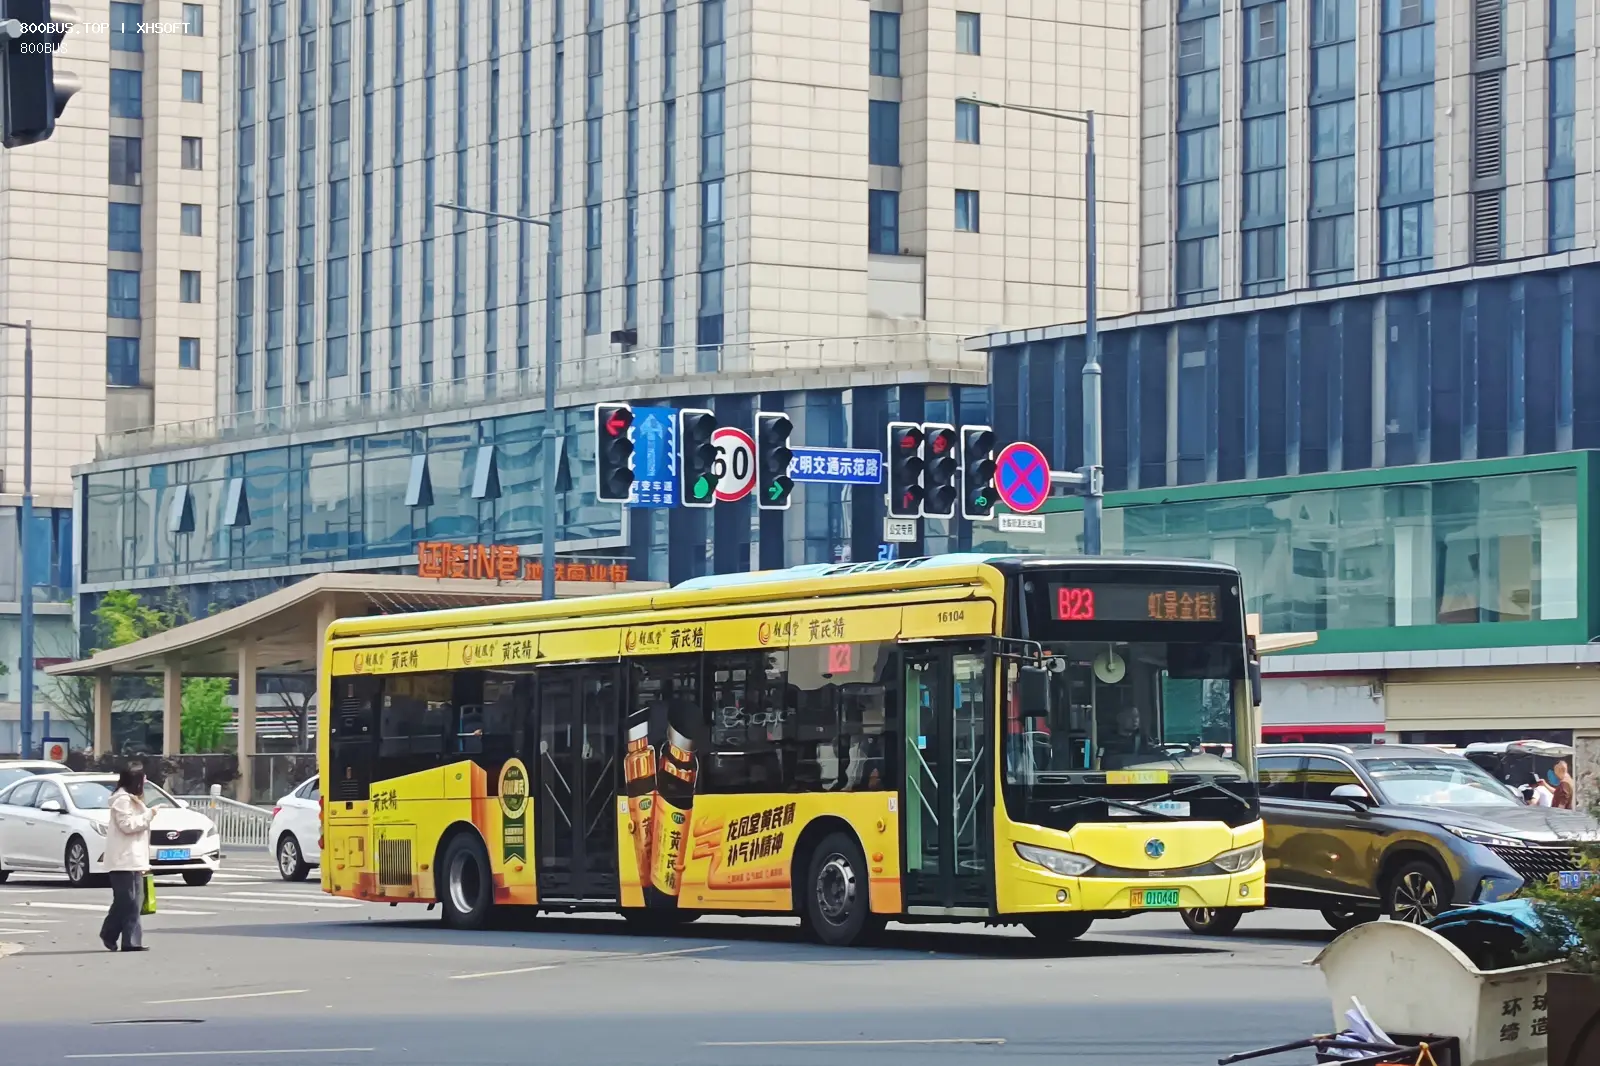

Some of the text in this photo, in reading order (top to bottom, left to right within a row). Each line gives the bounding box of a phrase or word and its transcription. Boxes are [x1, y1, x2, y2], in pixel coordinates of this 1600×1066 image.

[714, 446, 749, 480] 60
[789, 455, 878, 477] 文明交通示范路
[937, 610, 964, 623] 16104
[1058, 587, 1095, 620] B23
[726, 802, 797, 843] 龙凤堂黄芪精
[727, 831, 784, 867] 补气补精神
[1501, 994, 1548, 1018] 环球
